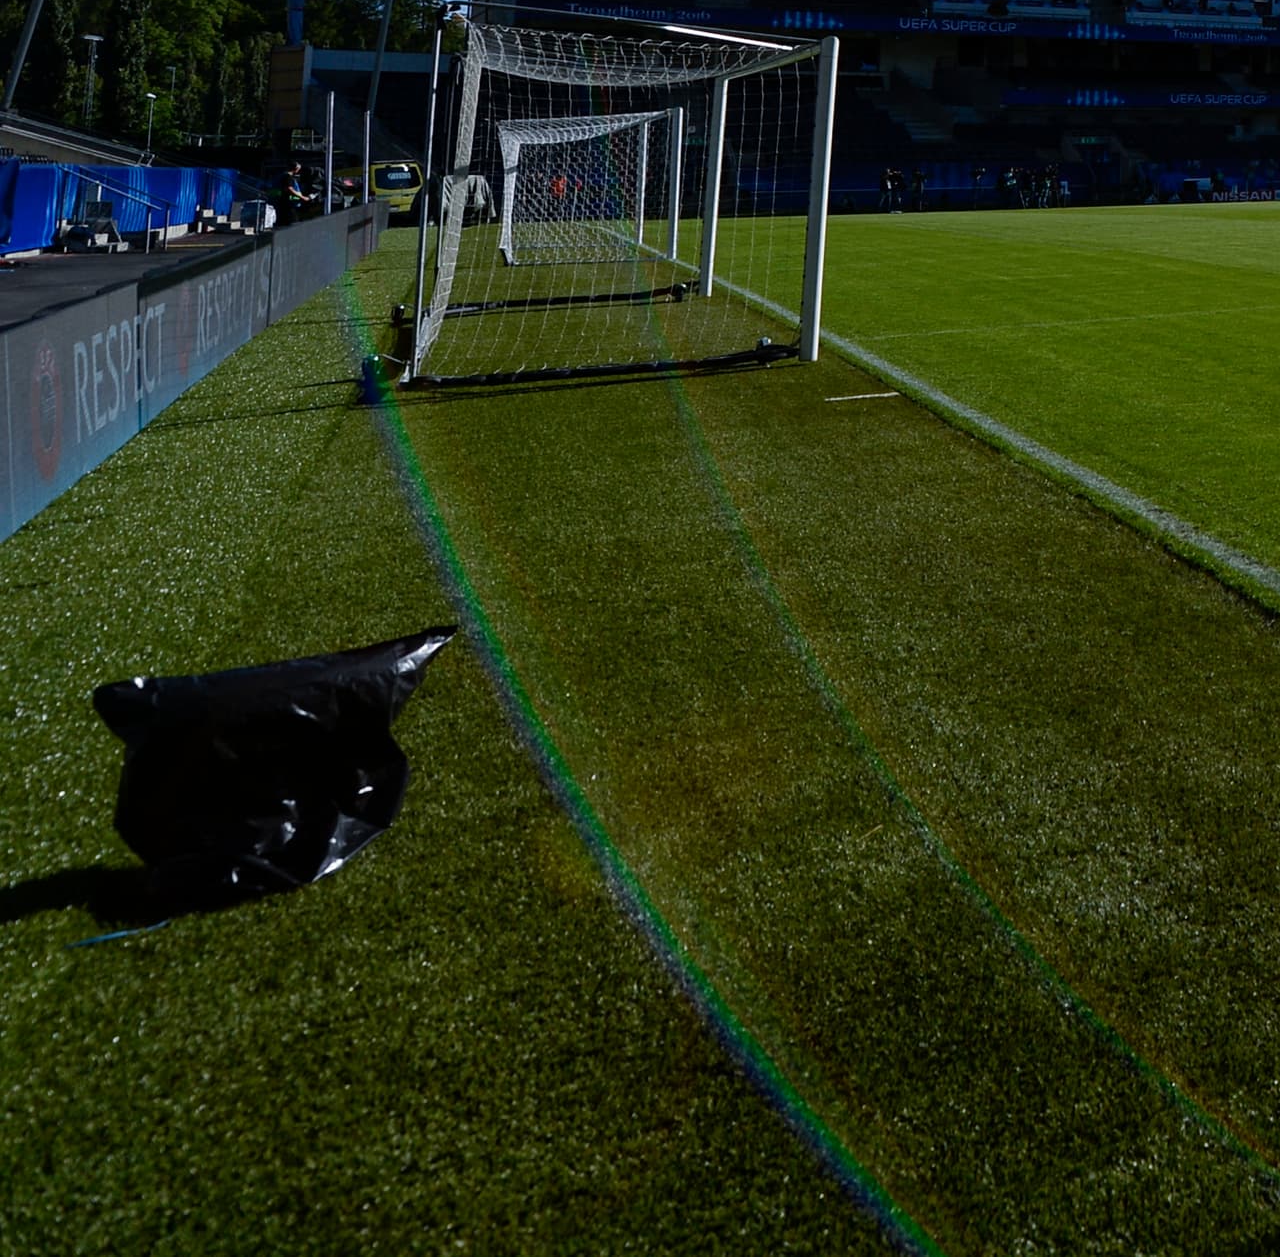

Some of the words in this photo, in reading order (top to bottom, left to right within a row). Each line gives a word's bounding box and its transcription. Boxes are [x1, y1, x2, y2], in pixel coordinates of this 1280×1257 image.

[677, 9, 711, 22] 2016
[900, 17, 938, 30] UEFA
[1170, 94, 1202, 104] UEFA
[1212, 190, 1272, 201] NISSAN
[196, 263, 250, 355] RESPECT
[74, 302, 166, 443] RESPECT
